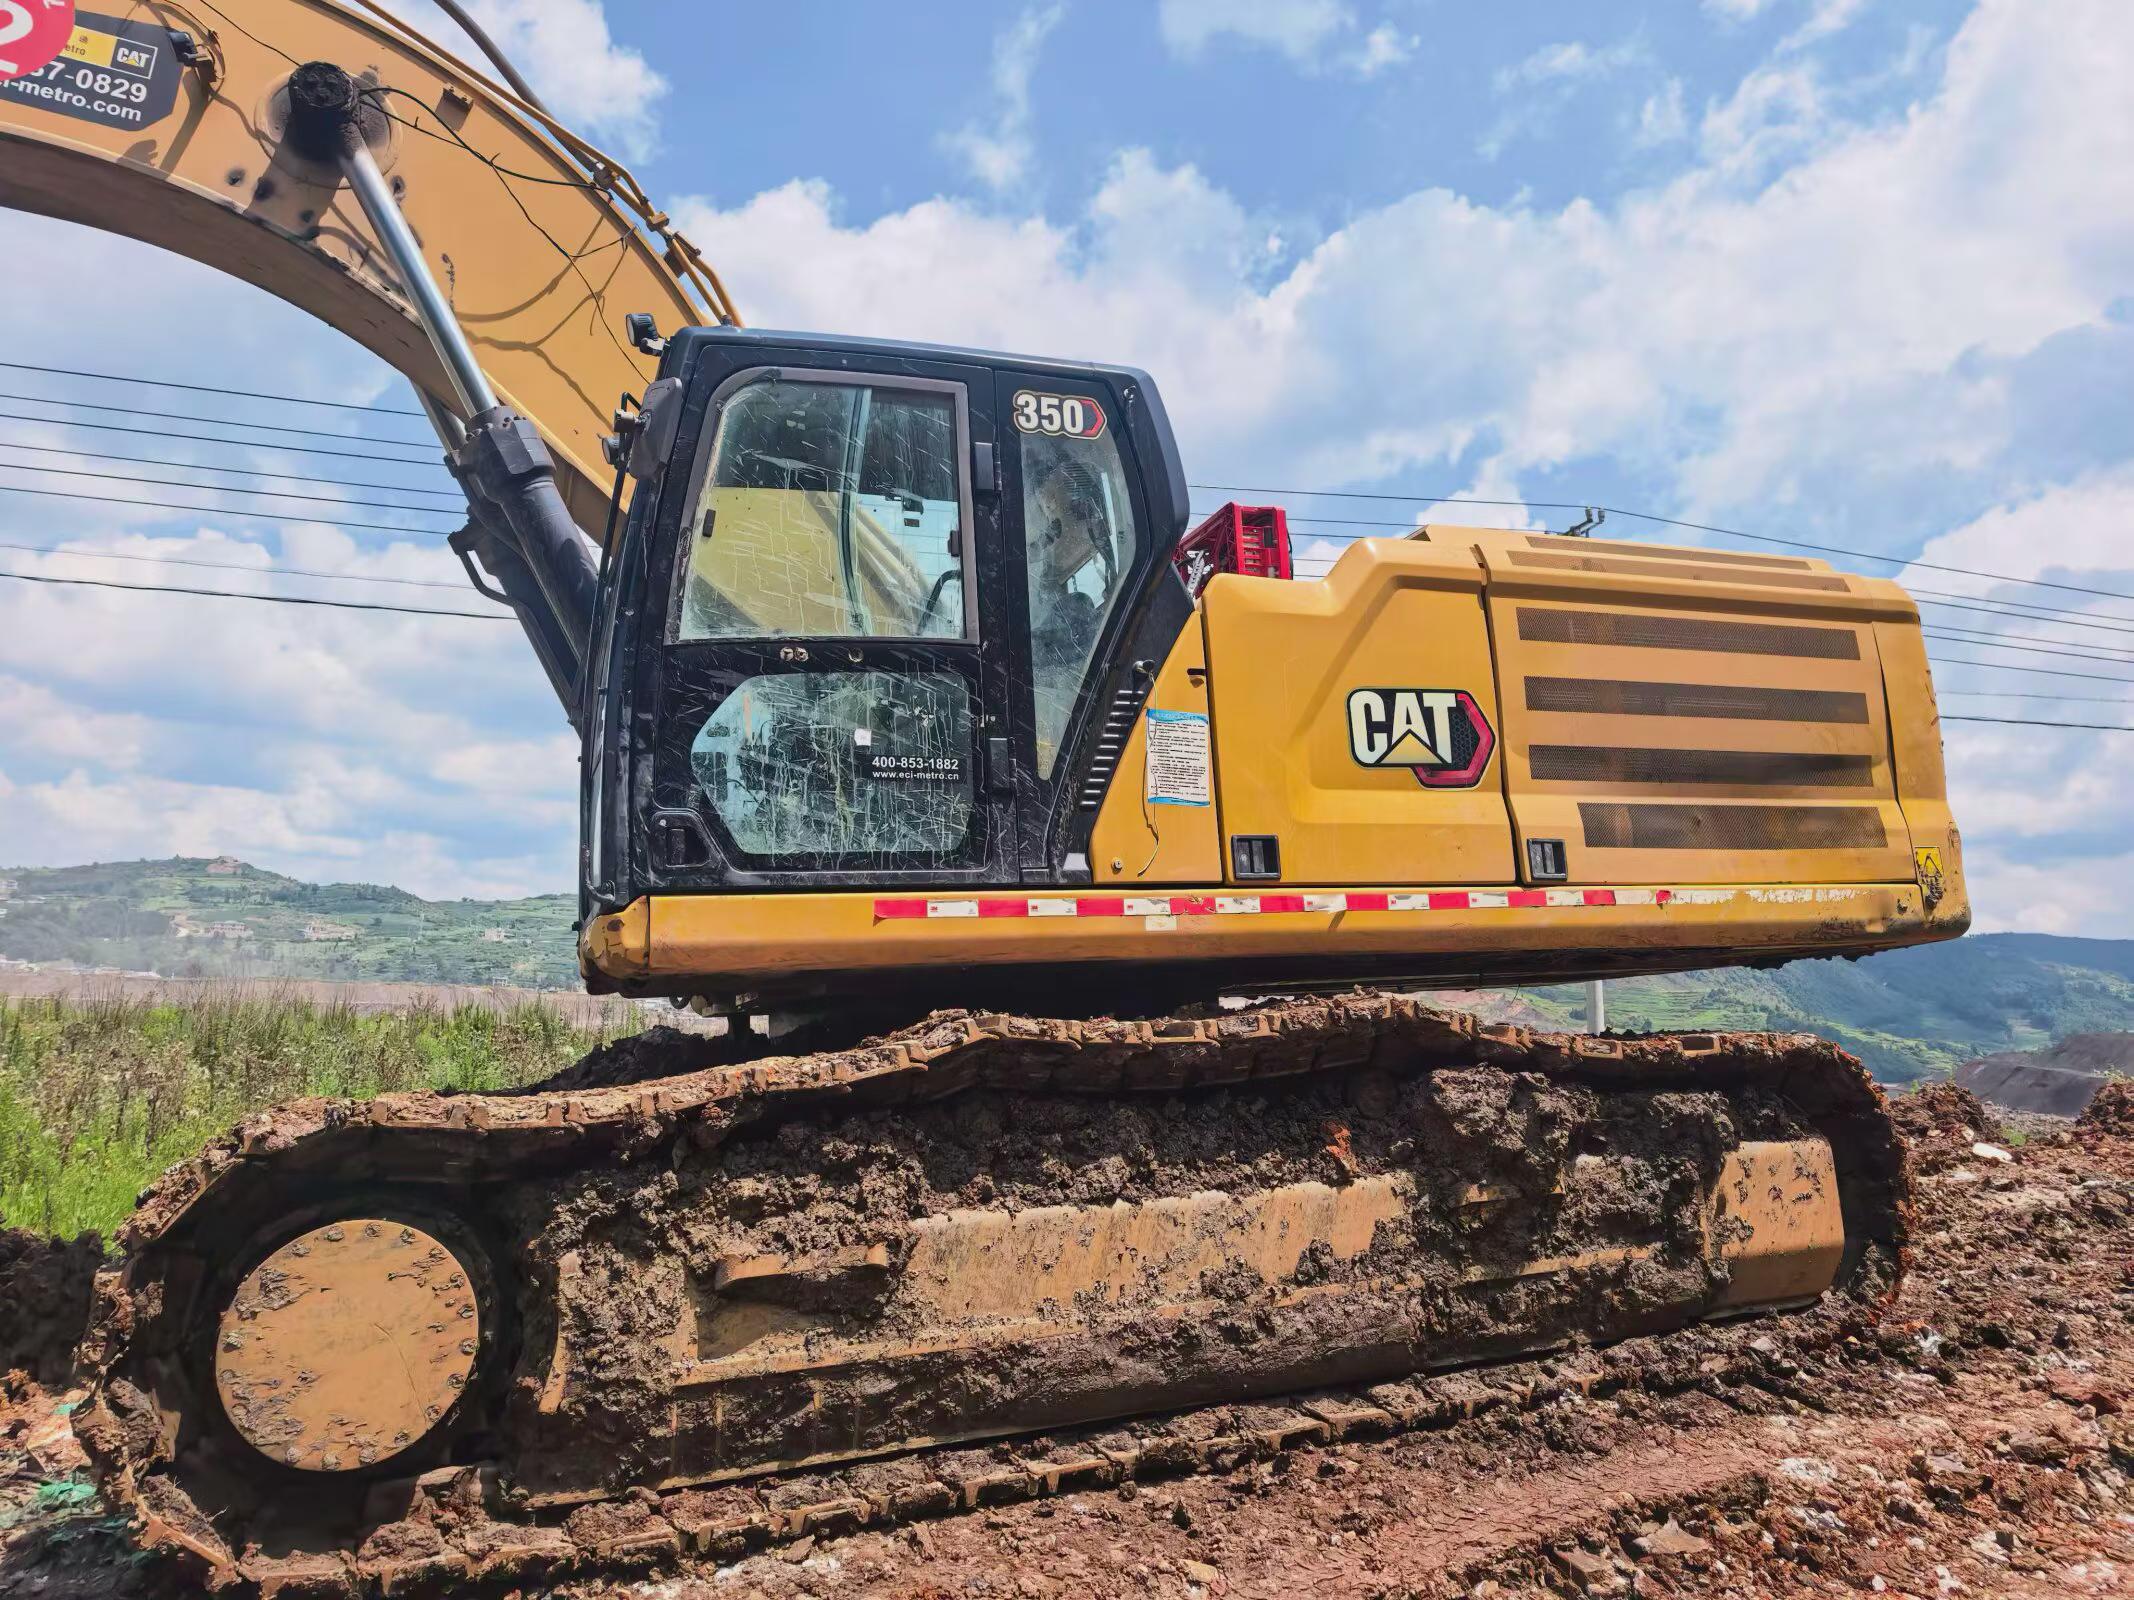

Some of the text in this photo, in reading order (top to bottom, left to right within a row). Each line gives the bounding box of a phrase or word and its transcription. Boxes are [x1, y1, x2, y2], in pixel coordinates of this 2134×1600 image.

[116, 47, 150, 68] CAT
[0, 79, 141, 122] i-metro.com
[31, 61, 147, 103] 7-0829
[1017, 394, 1083, 433] 350
[1350, 691, 1456, 764] CAT
[872, 756, 959, 770] 400-853-1882
[872, 770, 959, 780] www.eci-metro.cn
